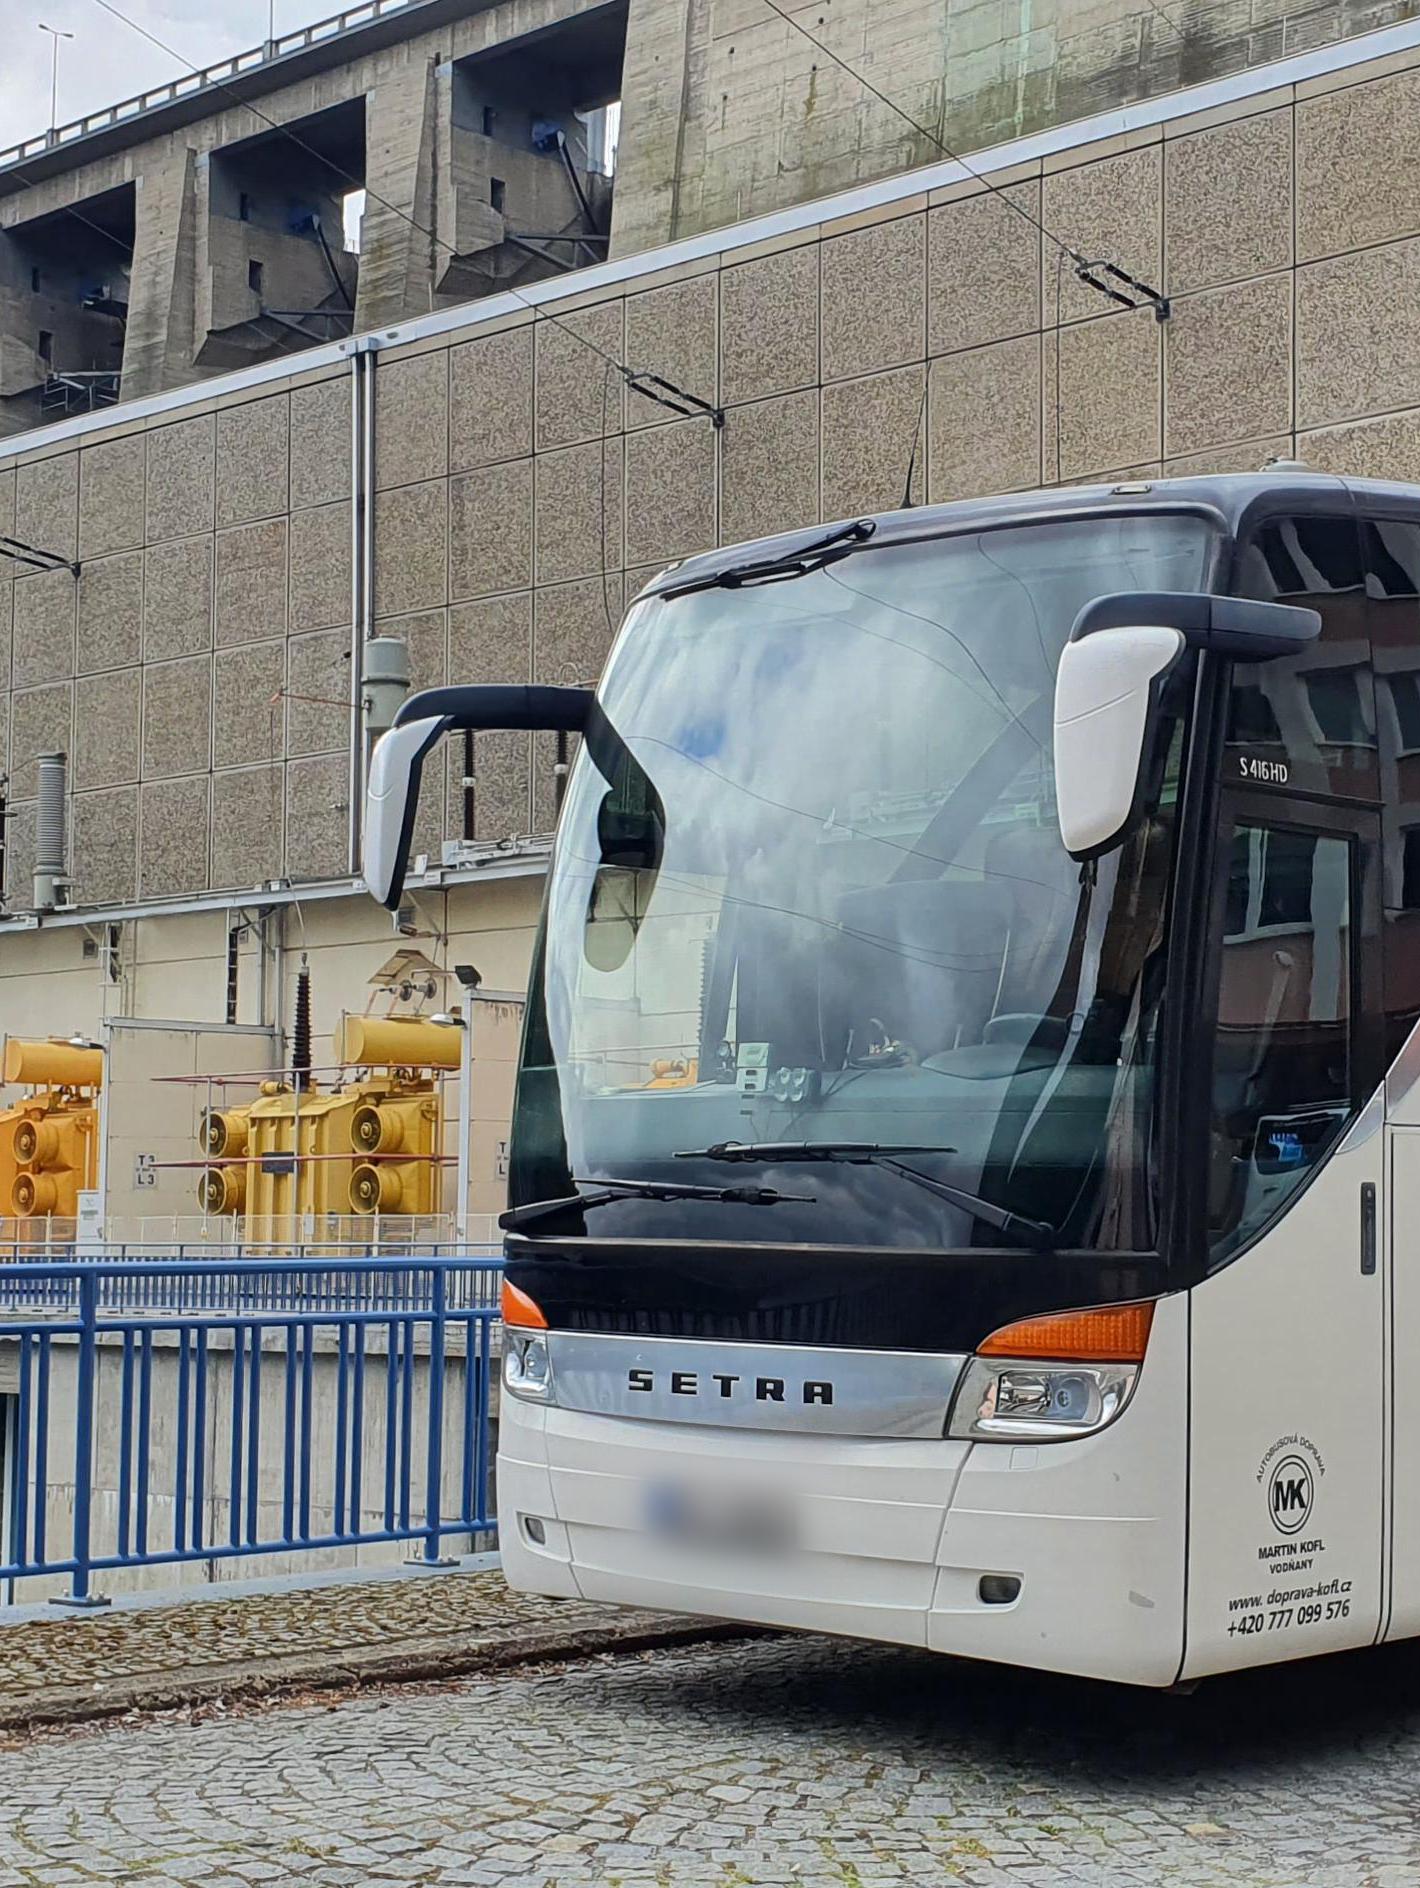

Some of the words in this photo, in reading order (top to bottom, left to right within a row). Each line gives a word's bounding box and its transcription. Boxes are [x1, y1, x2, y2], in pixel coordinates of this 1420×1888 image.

[1240, 757, 1248, 776] S
[1250, 759, 1288, 783] 416HD
[138, 1174, 154, 1185] L3
[628, 1369, 833, 1405] SETRA
[1274, 1478, 1307, 1512] MK
[1258, 1543, 1297, 1560] MARTIN
[1300, 1539, 1326, 1554] KOFL
[1228, 1596, 1263, 1612] www.
[1266, 1578, 1352, 1607] doprava-kofl.cz
[1227, 1613, 1264, 1637] +420
[1268, 1608, 1294, 1631] 777
[1297, 1603, 1322, 1625] 099
[1325, 1599, 1351, 1620] 576
